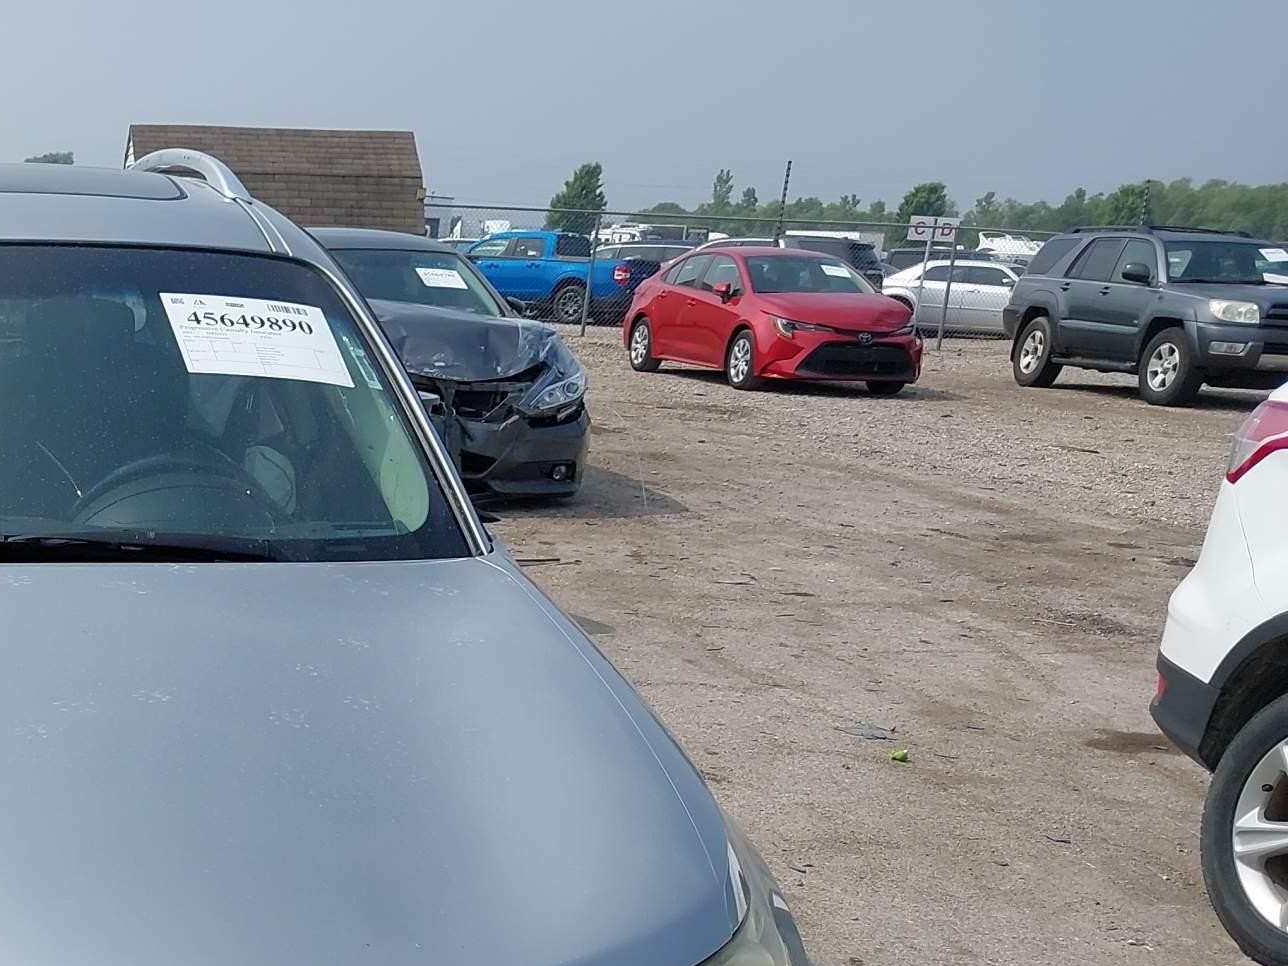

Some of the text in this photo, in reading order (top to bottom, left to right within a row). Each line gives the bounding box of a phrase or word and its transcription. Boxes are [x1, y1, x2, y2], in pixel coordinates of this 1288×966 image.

[914, 221, 926, 235] C
[940, 222, 953, 237] D
[187, 310, 313, 335] 45649890
